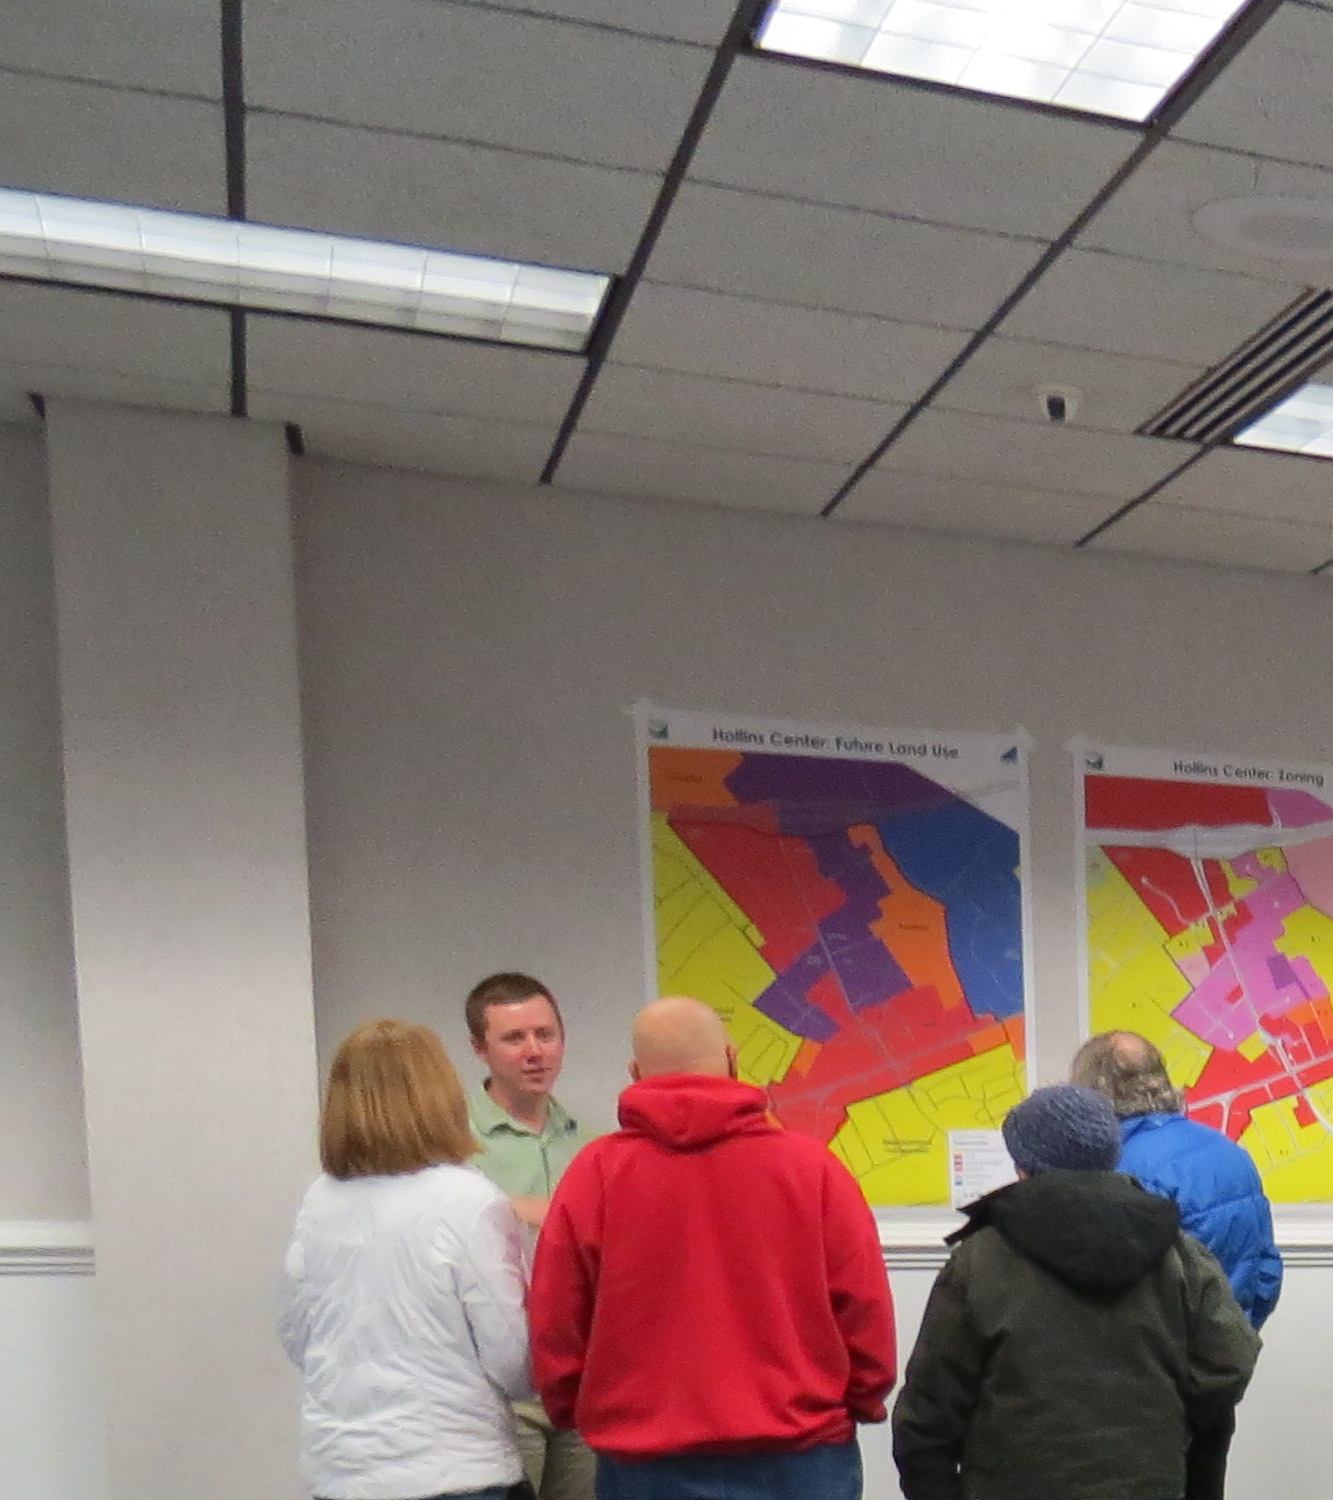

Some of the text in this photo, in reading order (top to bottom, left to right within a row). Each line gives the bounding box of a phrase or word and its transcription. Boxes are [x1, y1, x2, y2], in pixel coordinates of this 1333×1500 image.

[712, 727, 765, 746] Hollins
[835, 736, 883, 754] Future
[888, 741, 926, 758] Land
[932, 744, 959, 760] Use
[1173, 760, 1218, 779] Hollins
[1278, 768, 1325, 787] Zoning
